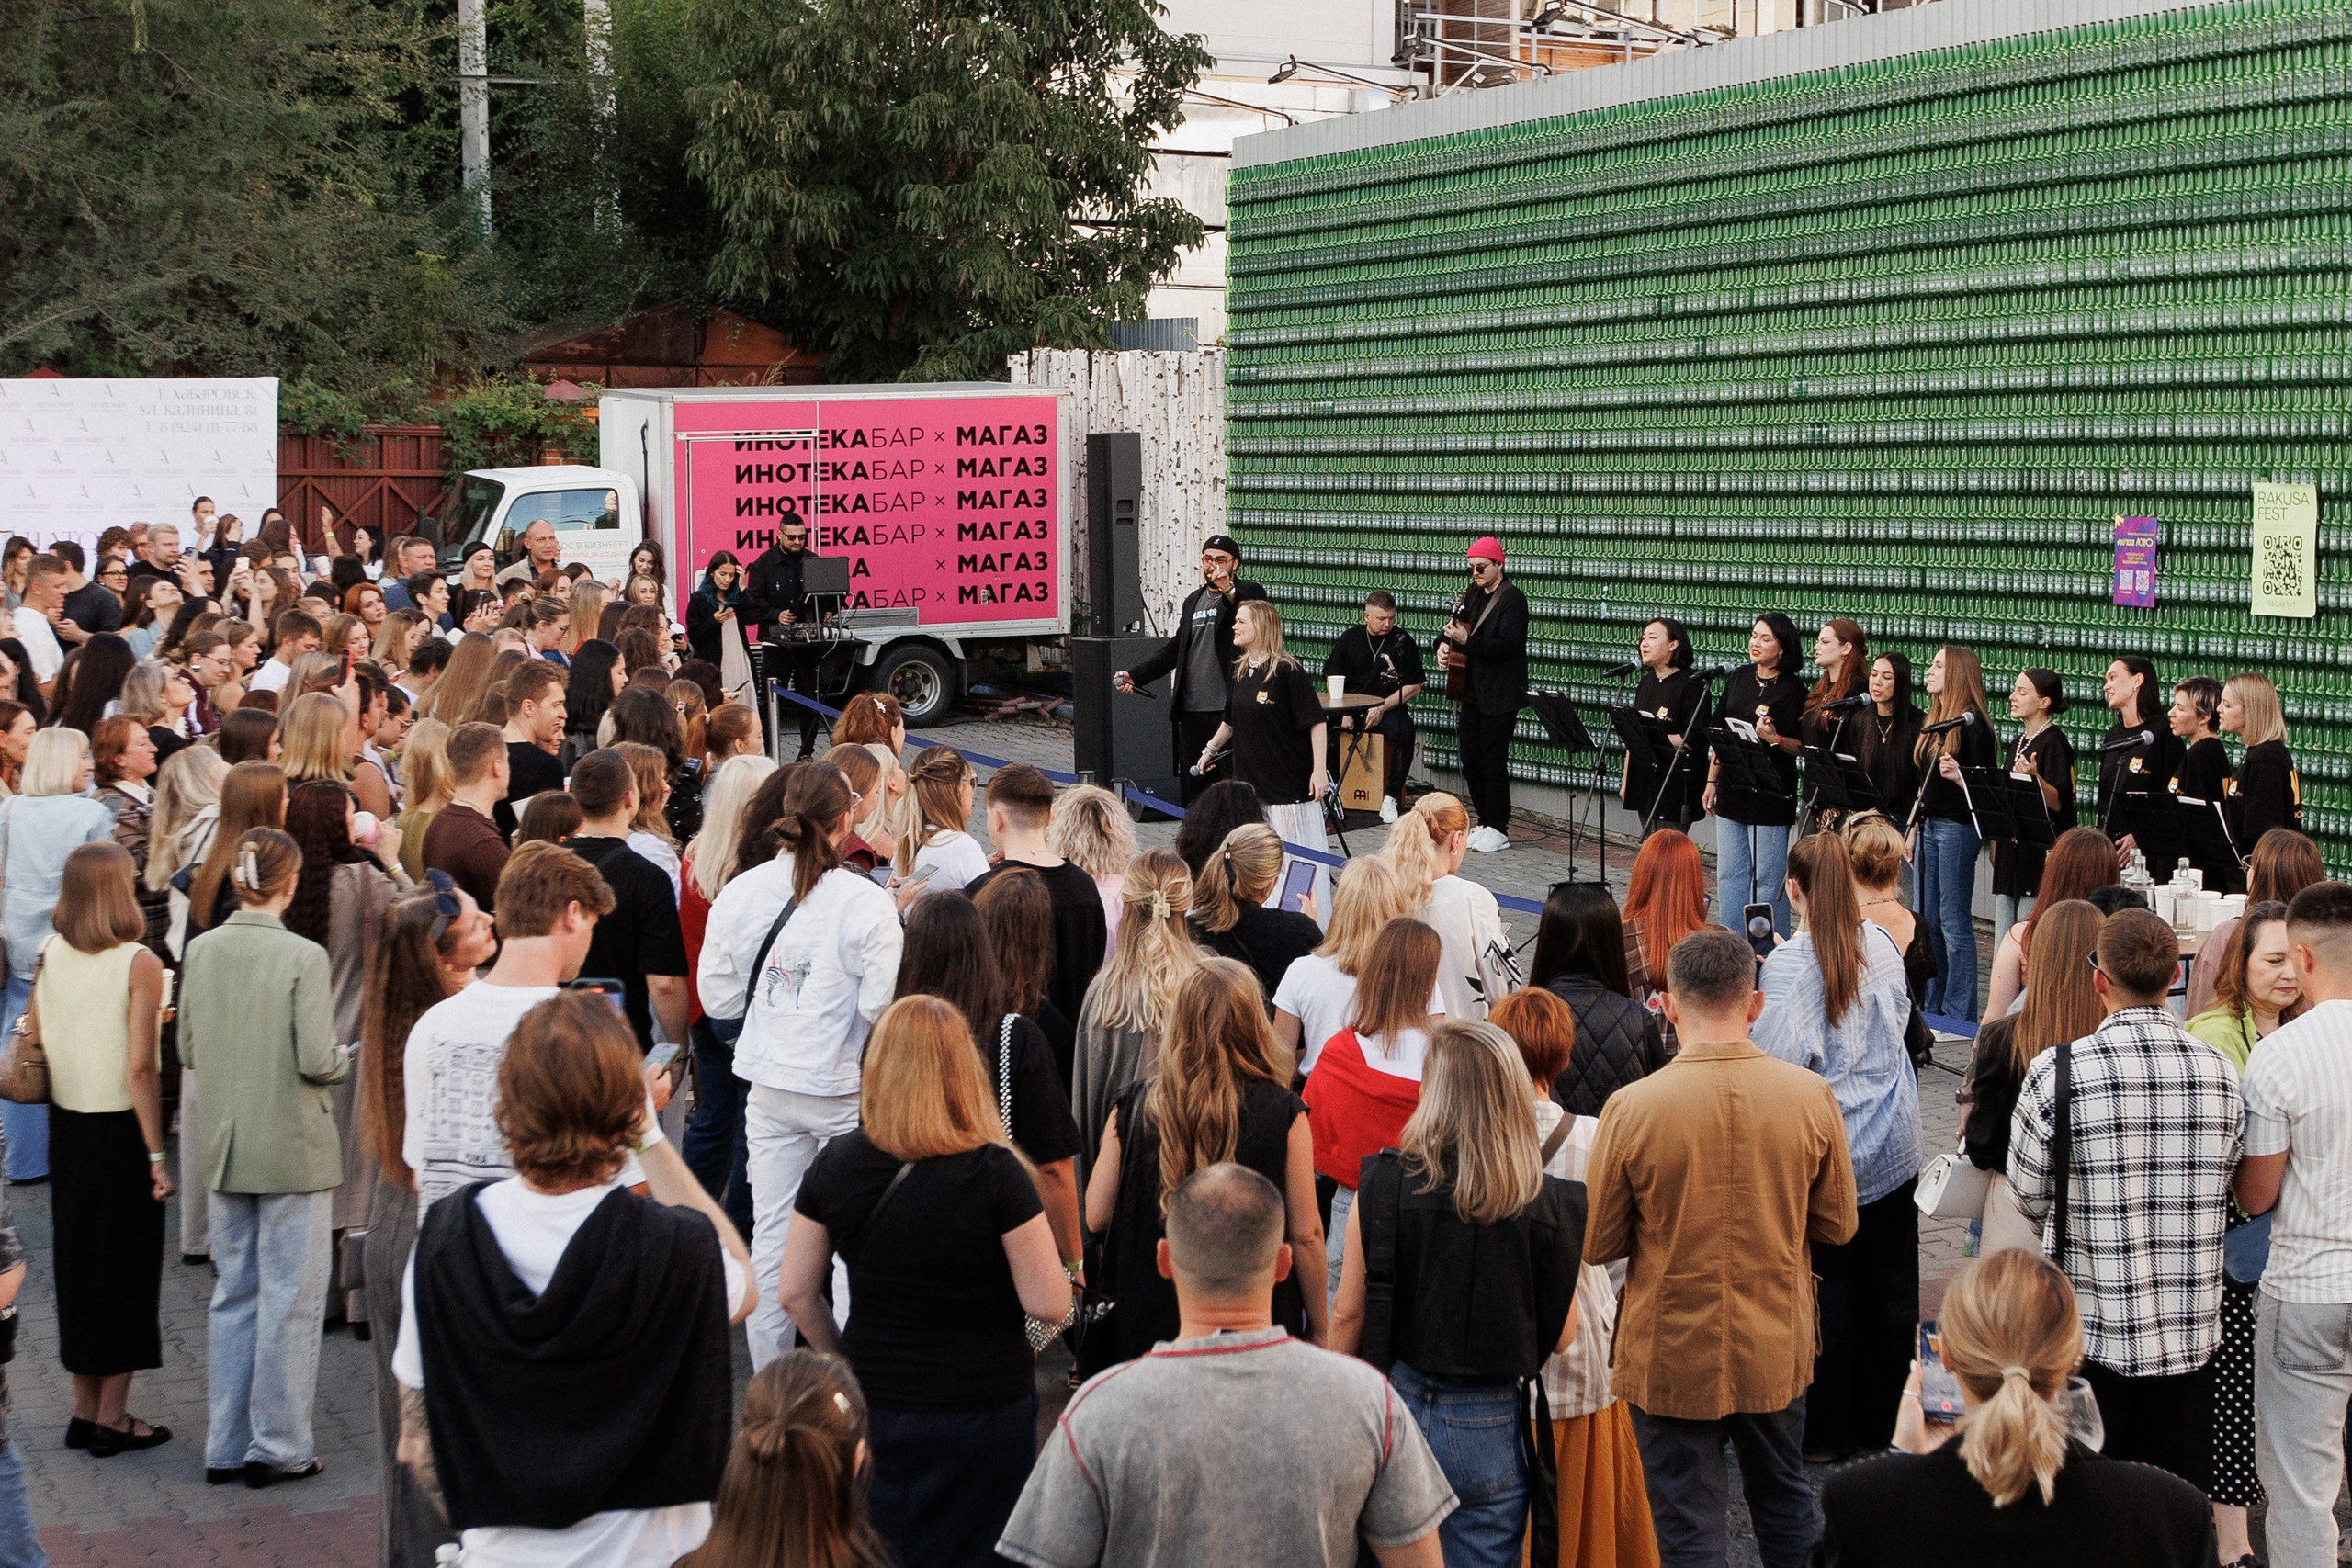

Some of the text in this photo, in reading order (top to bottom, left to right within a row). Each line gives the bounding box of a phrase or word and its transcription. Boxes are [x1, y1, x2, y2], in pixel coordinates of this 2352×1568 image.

[244, 405, 257, 415] 81
[160, 422, 167, 433] 8
[206, 421, 258, 433] 111-77-88
[957, 424, 1047, 446] МАГАЗ
[957, 457, 1047, 478] МАГАЗ
[957, 489, 1047, 510] МАГАЗ
[2258, 491, 2310, 505] RAKUSA
[2258, 507, 2288, 520] FEST
[584, 540, 628, 549] БИЗНЕСЕ?
[736, 524, 925, 549] ИНТЕКАБАР
[957, 520, 1047, 542] МАГАЗ
[958, 551, 1047, 573] МАГАЗ
[958, 582, 1048, 604] МАГАЗ
